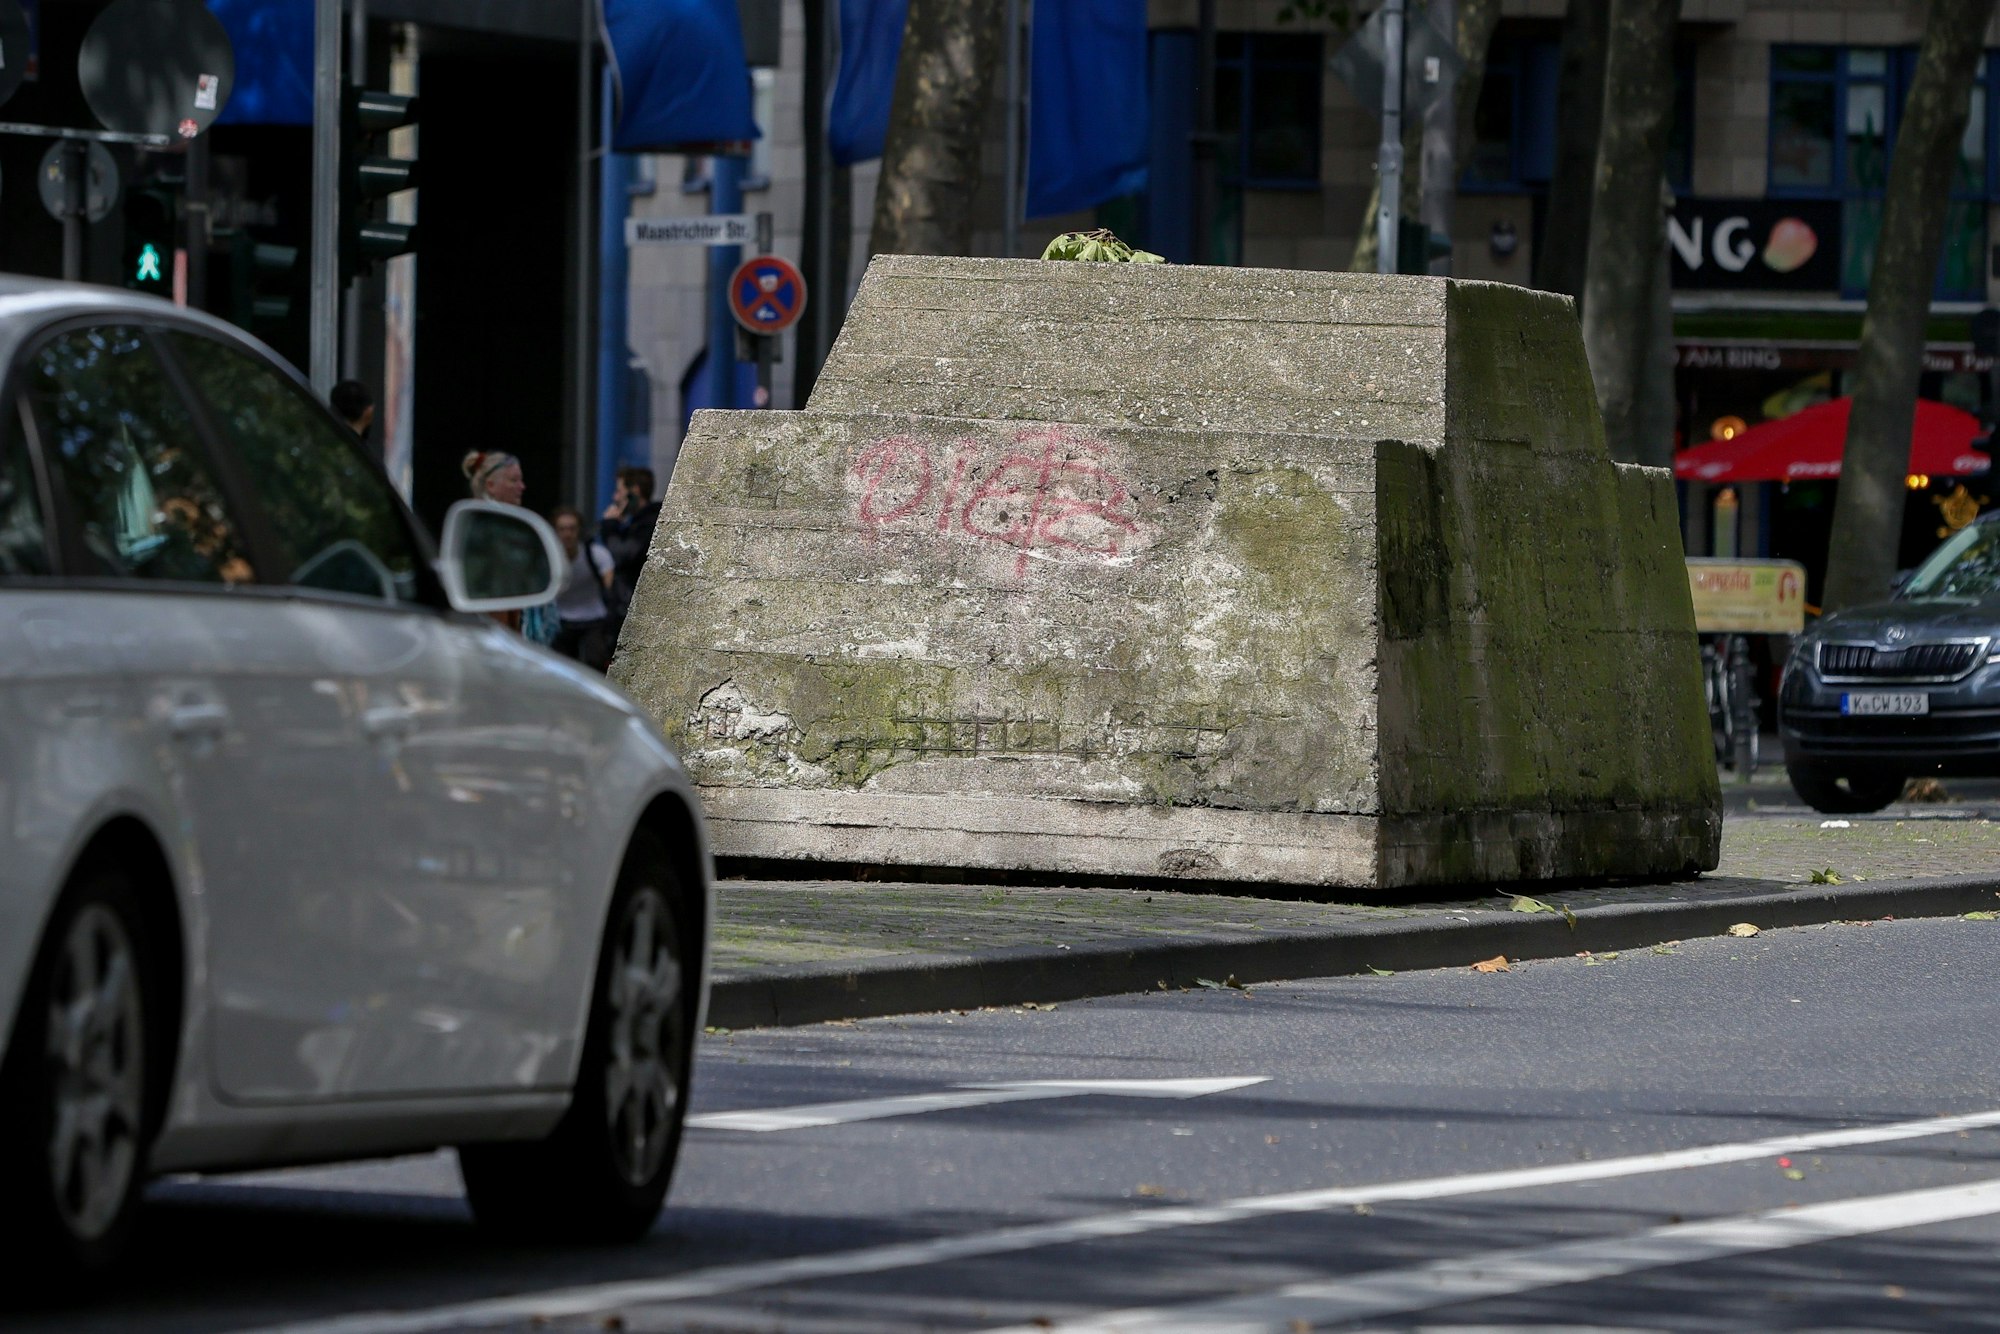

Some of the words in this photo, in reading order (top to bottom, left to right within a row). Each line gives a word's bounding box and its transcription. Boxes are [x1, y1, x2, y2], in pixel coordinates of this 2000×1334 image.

[636, 221, 721, 241] Maastrichter
[725, 219, 750, 239] Str.
[1727, 348, 1782, 370] RING
